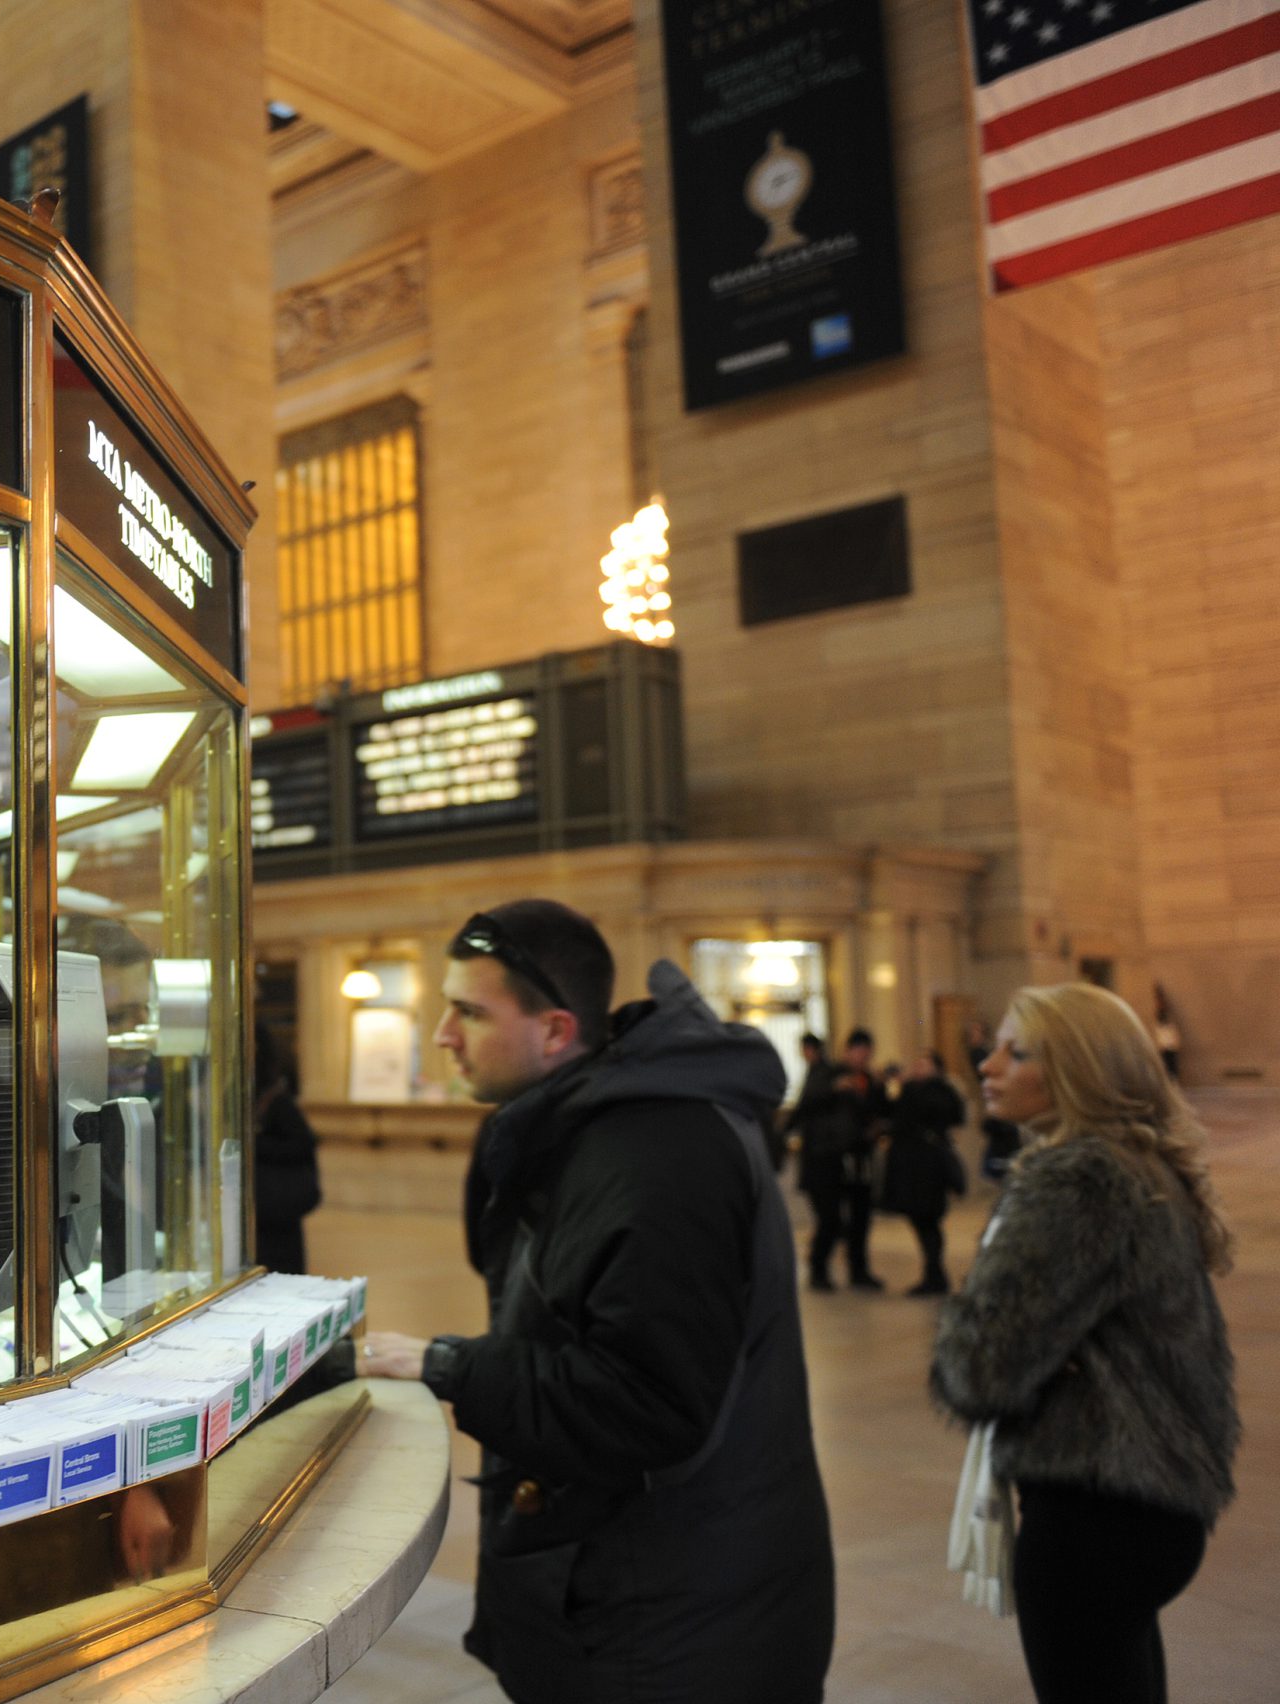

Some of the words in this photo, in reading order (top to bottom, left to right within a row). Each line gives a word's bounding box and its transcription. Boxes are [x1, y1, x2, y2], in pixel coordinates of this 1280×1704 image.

[87, 420, 123, 491] MTA
[124, 460, 214, 588] METRO-NORTH
[118, 503, 196, 610] TIMETABLES
